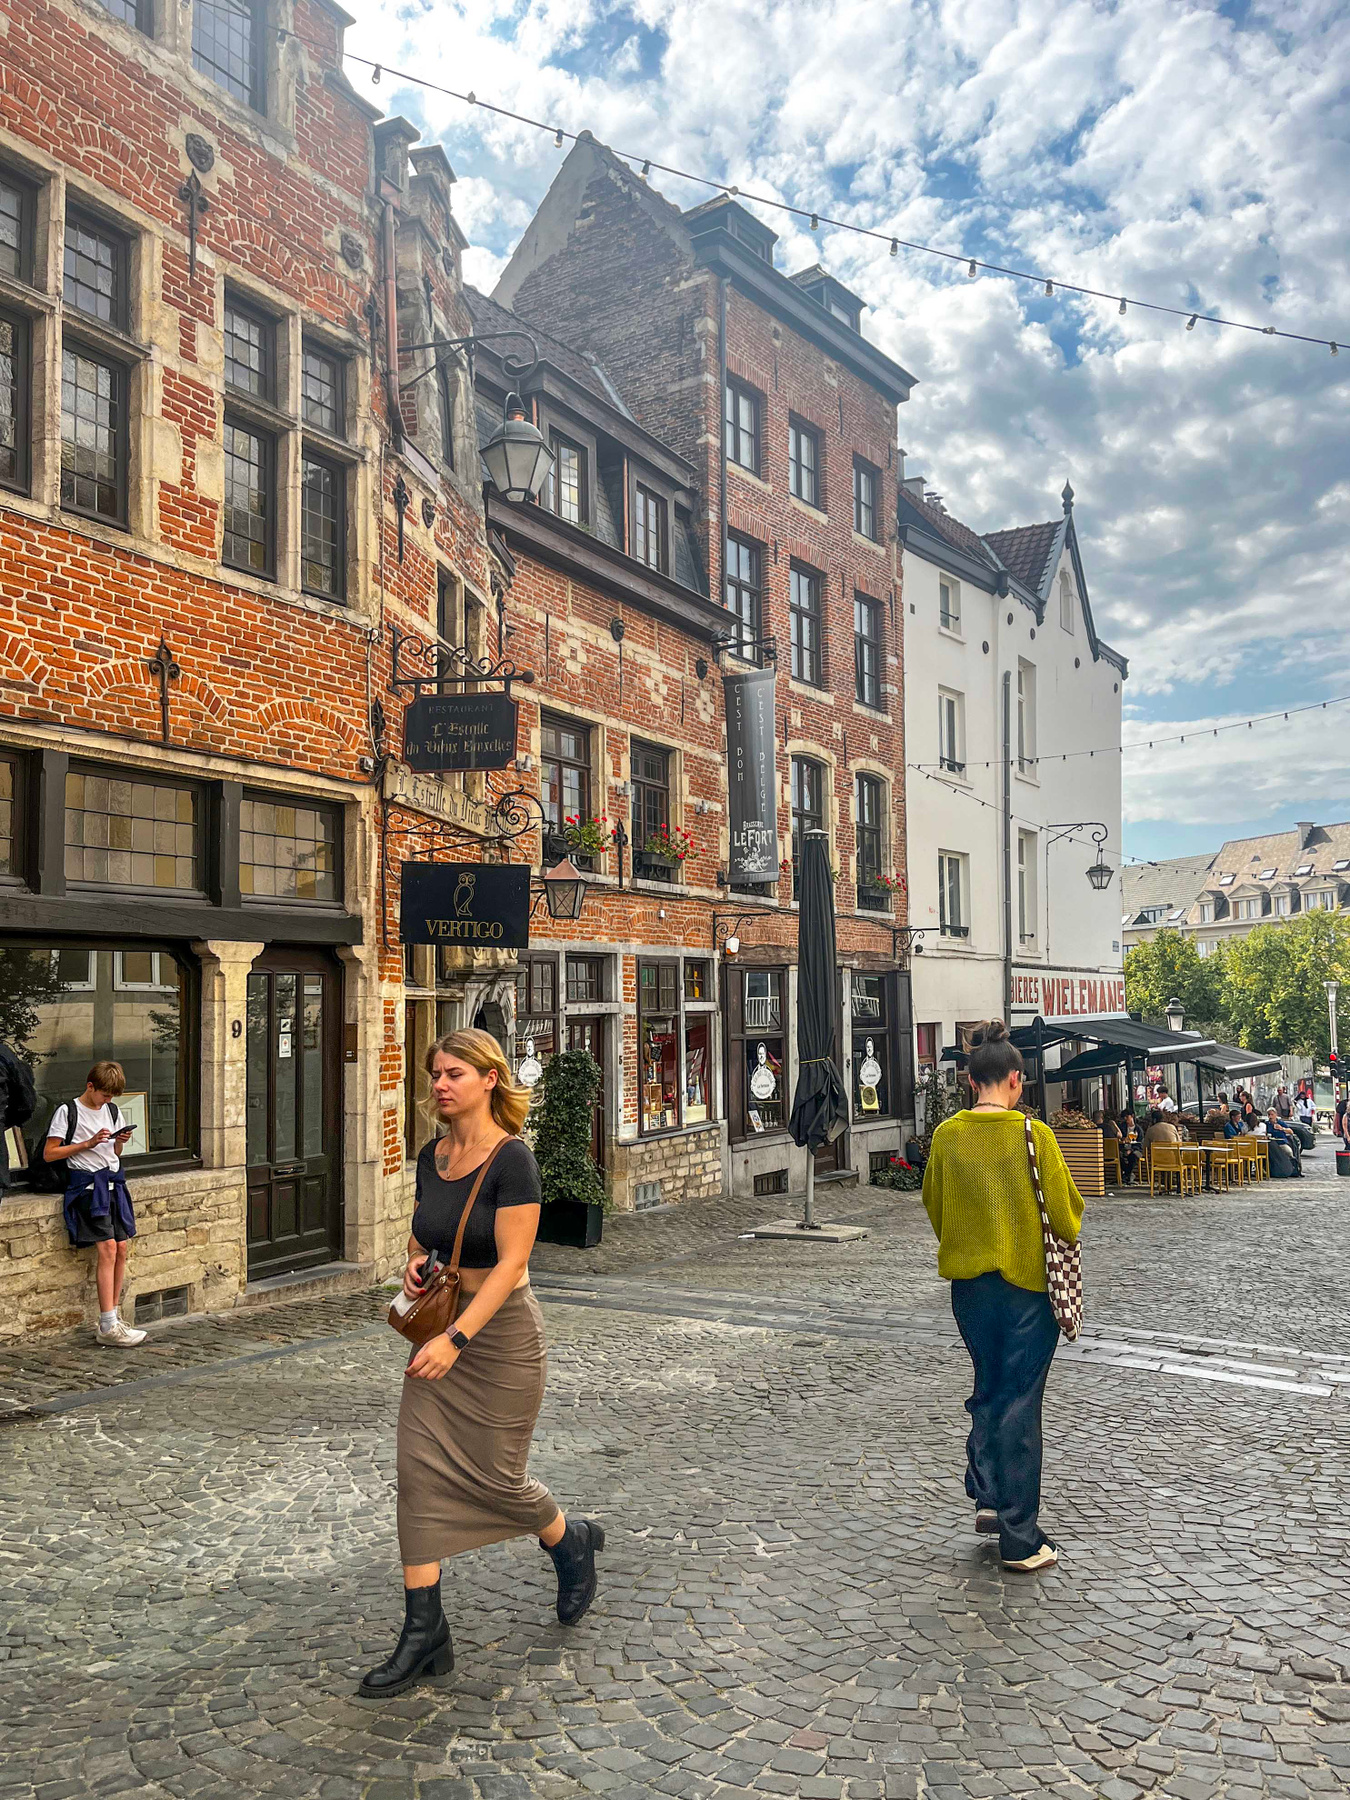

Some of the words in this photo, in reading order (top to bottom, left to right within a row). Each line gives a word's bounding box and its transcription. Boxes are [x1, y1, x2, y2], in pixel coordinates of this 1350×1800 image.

[429, 703, 494, 714] RESTAURANT
[406, 741, 420, 756] du
[424, 739, 458, 754] Vieux
[463, 738, 512, 754] Bruxelles
[425, 919, 504, 939] VERTIGO
[1011, 975, 1039, 1004] BIERES
[1041, 977, 1125, 1017] WIELEMANS
[231, 1019, 242, 1039] 9
